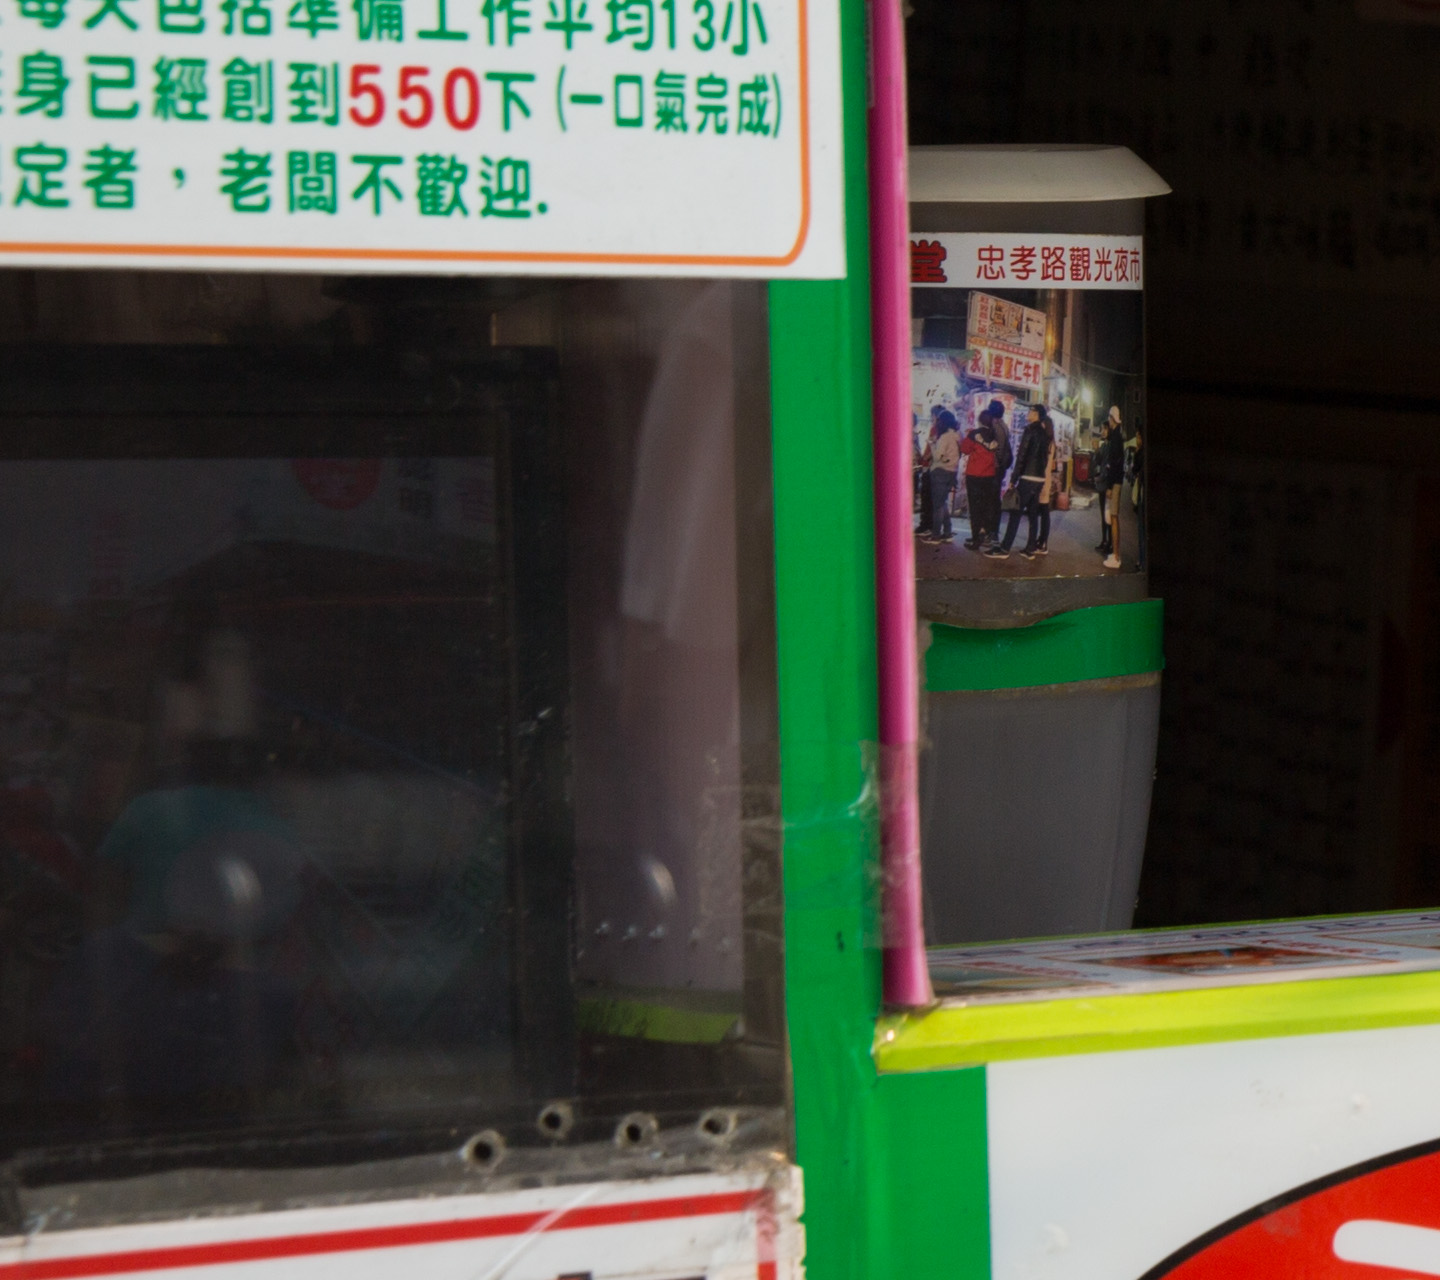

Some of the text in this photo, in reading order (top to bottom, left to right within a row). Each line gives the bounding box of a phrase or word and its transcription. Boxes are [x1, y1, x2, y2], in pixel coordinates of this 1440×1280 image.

[976, 245, 1142, 283] 忠孝路觀光夜市
